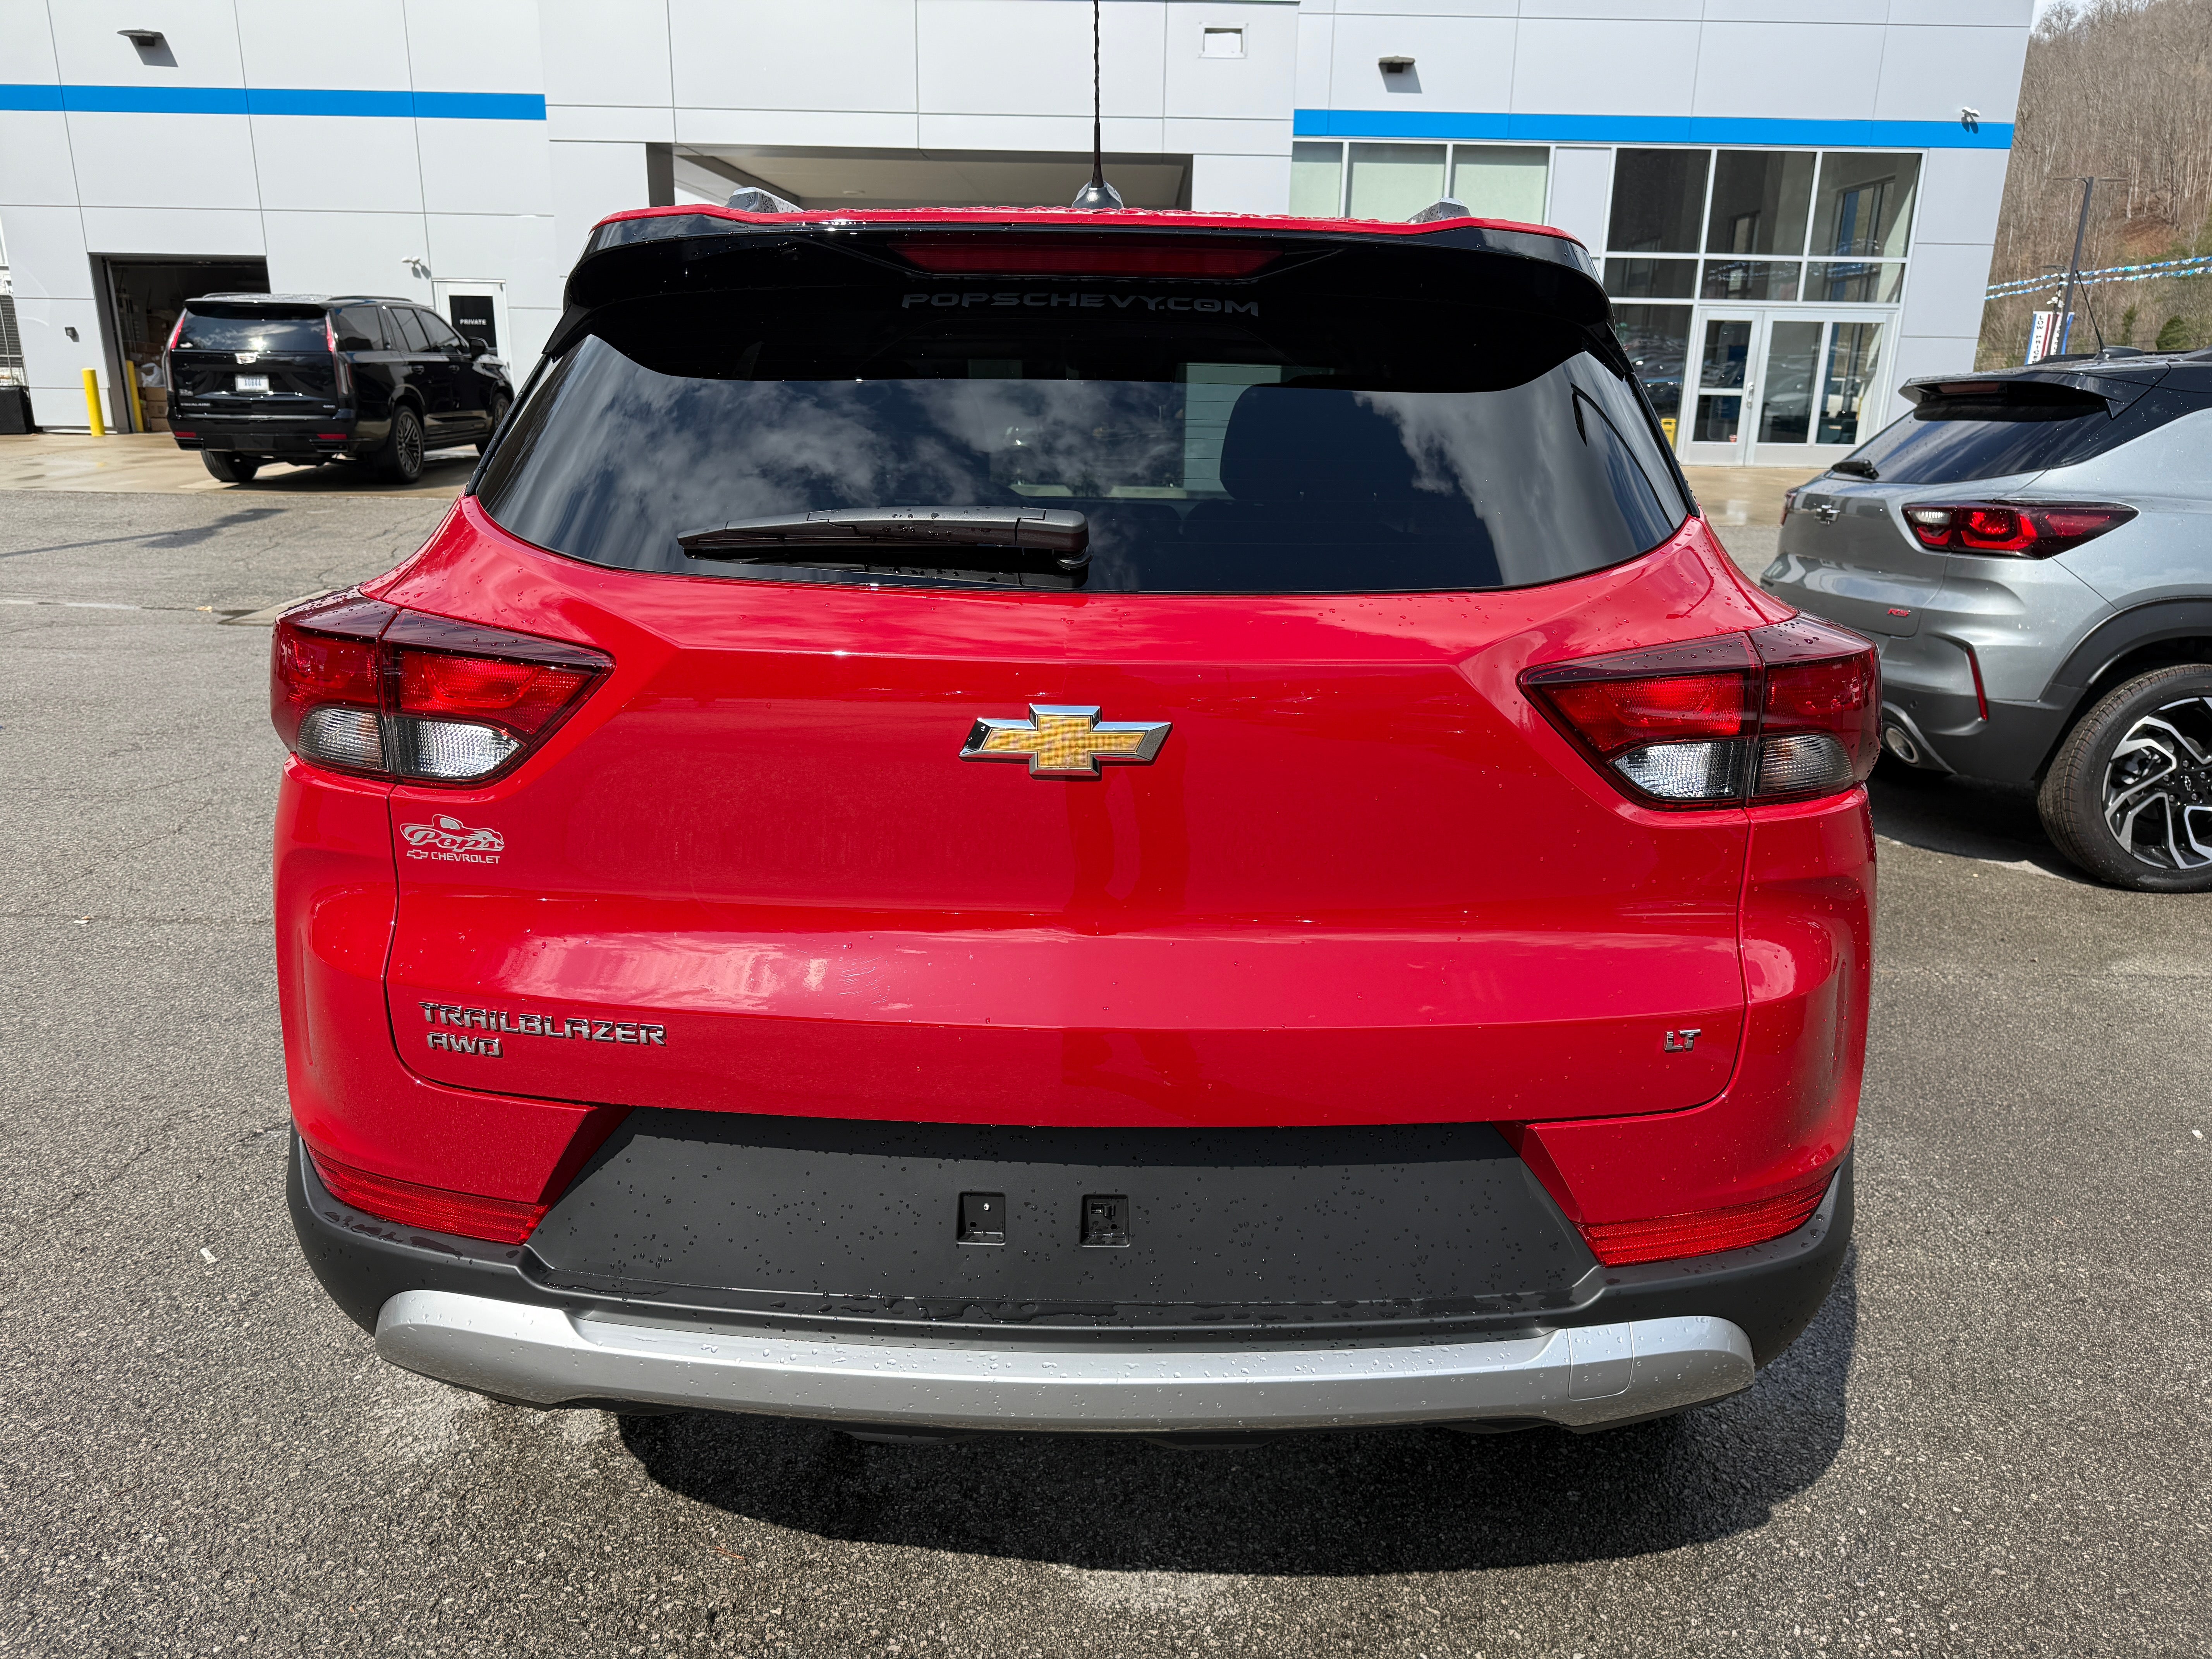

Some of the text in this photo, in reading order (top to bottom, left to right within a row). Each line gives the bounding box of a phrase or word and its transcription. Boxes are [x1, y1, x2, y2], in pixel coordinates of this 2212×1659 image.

[902, 292, 1259, 317] POPSCHEVY.COM
[1887, 608, 1910, 617] RS
[431, 852, 500, 864] CHEVROLET
[418, 1001, 666, 1046] TRAILBLAZER
[426, 1031, 503, 1058] AWD
[1664, 1029, 1701, 1053] LT
